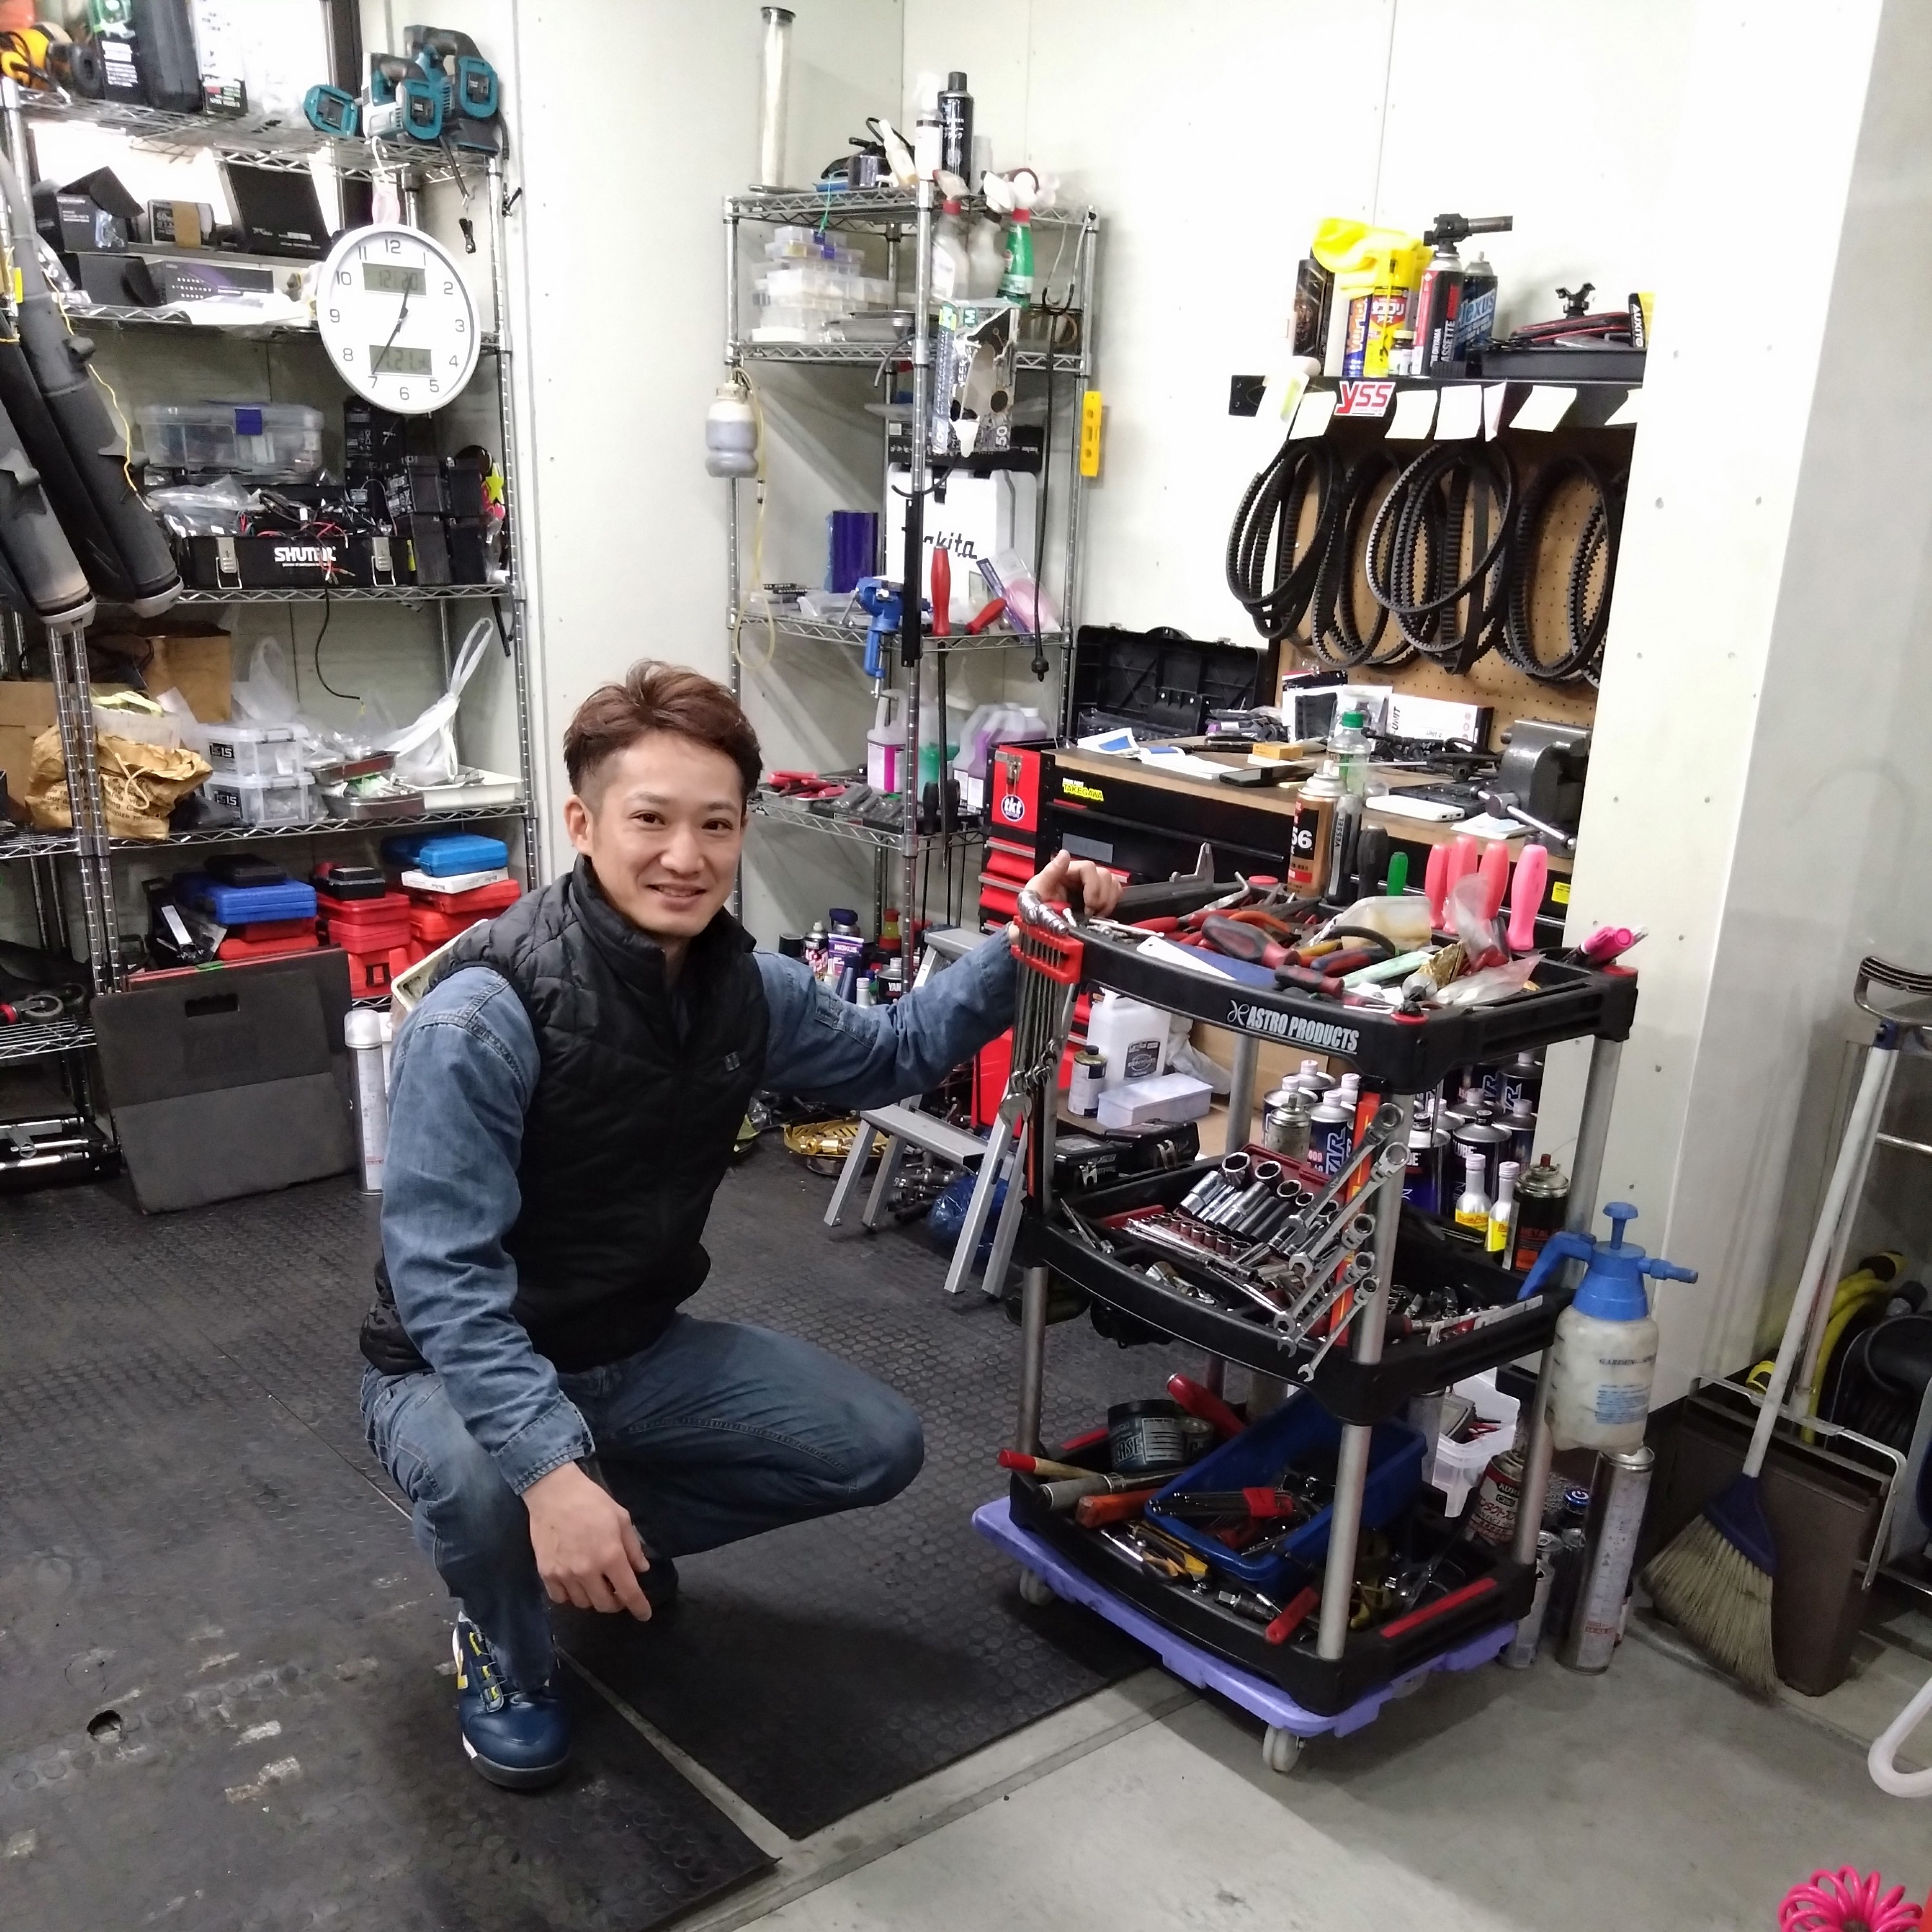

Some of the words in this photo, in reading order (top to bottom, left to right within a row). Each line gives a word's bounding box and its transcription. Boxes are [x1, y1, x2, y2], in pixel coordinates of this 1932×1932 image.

[358, 245, 367, 260] 11
[384, 239, 401, 254] 12
[422, 252, 426, 266] 1
[336, 270, 352, 285] 10
[443, 281, 453, 295] 2
[329, 308, 340, 323] 9
[455, 319, 465, 332] 3
[1633, 304, 1643, 347] AUXITO
[343, 348, 354, 361] 8
[448, 355, 459, 368] 4
[368, 376, 378, 388] 7
[429, 379, 439, 393] 5
[399, 386, 410, 400] 6
[1063, 783, 1104, 801] TAKEGAWA
[1004, 797, 1022, 815] tkt
[1334, 817, 1345, 847] VESSEL
[1246, 1006, 1289, 1034] ASTRO
[1288, 1016, 1359, 1051] PRODUCTS
